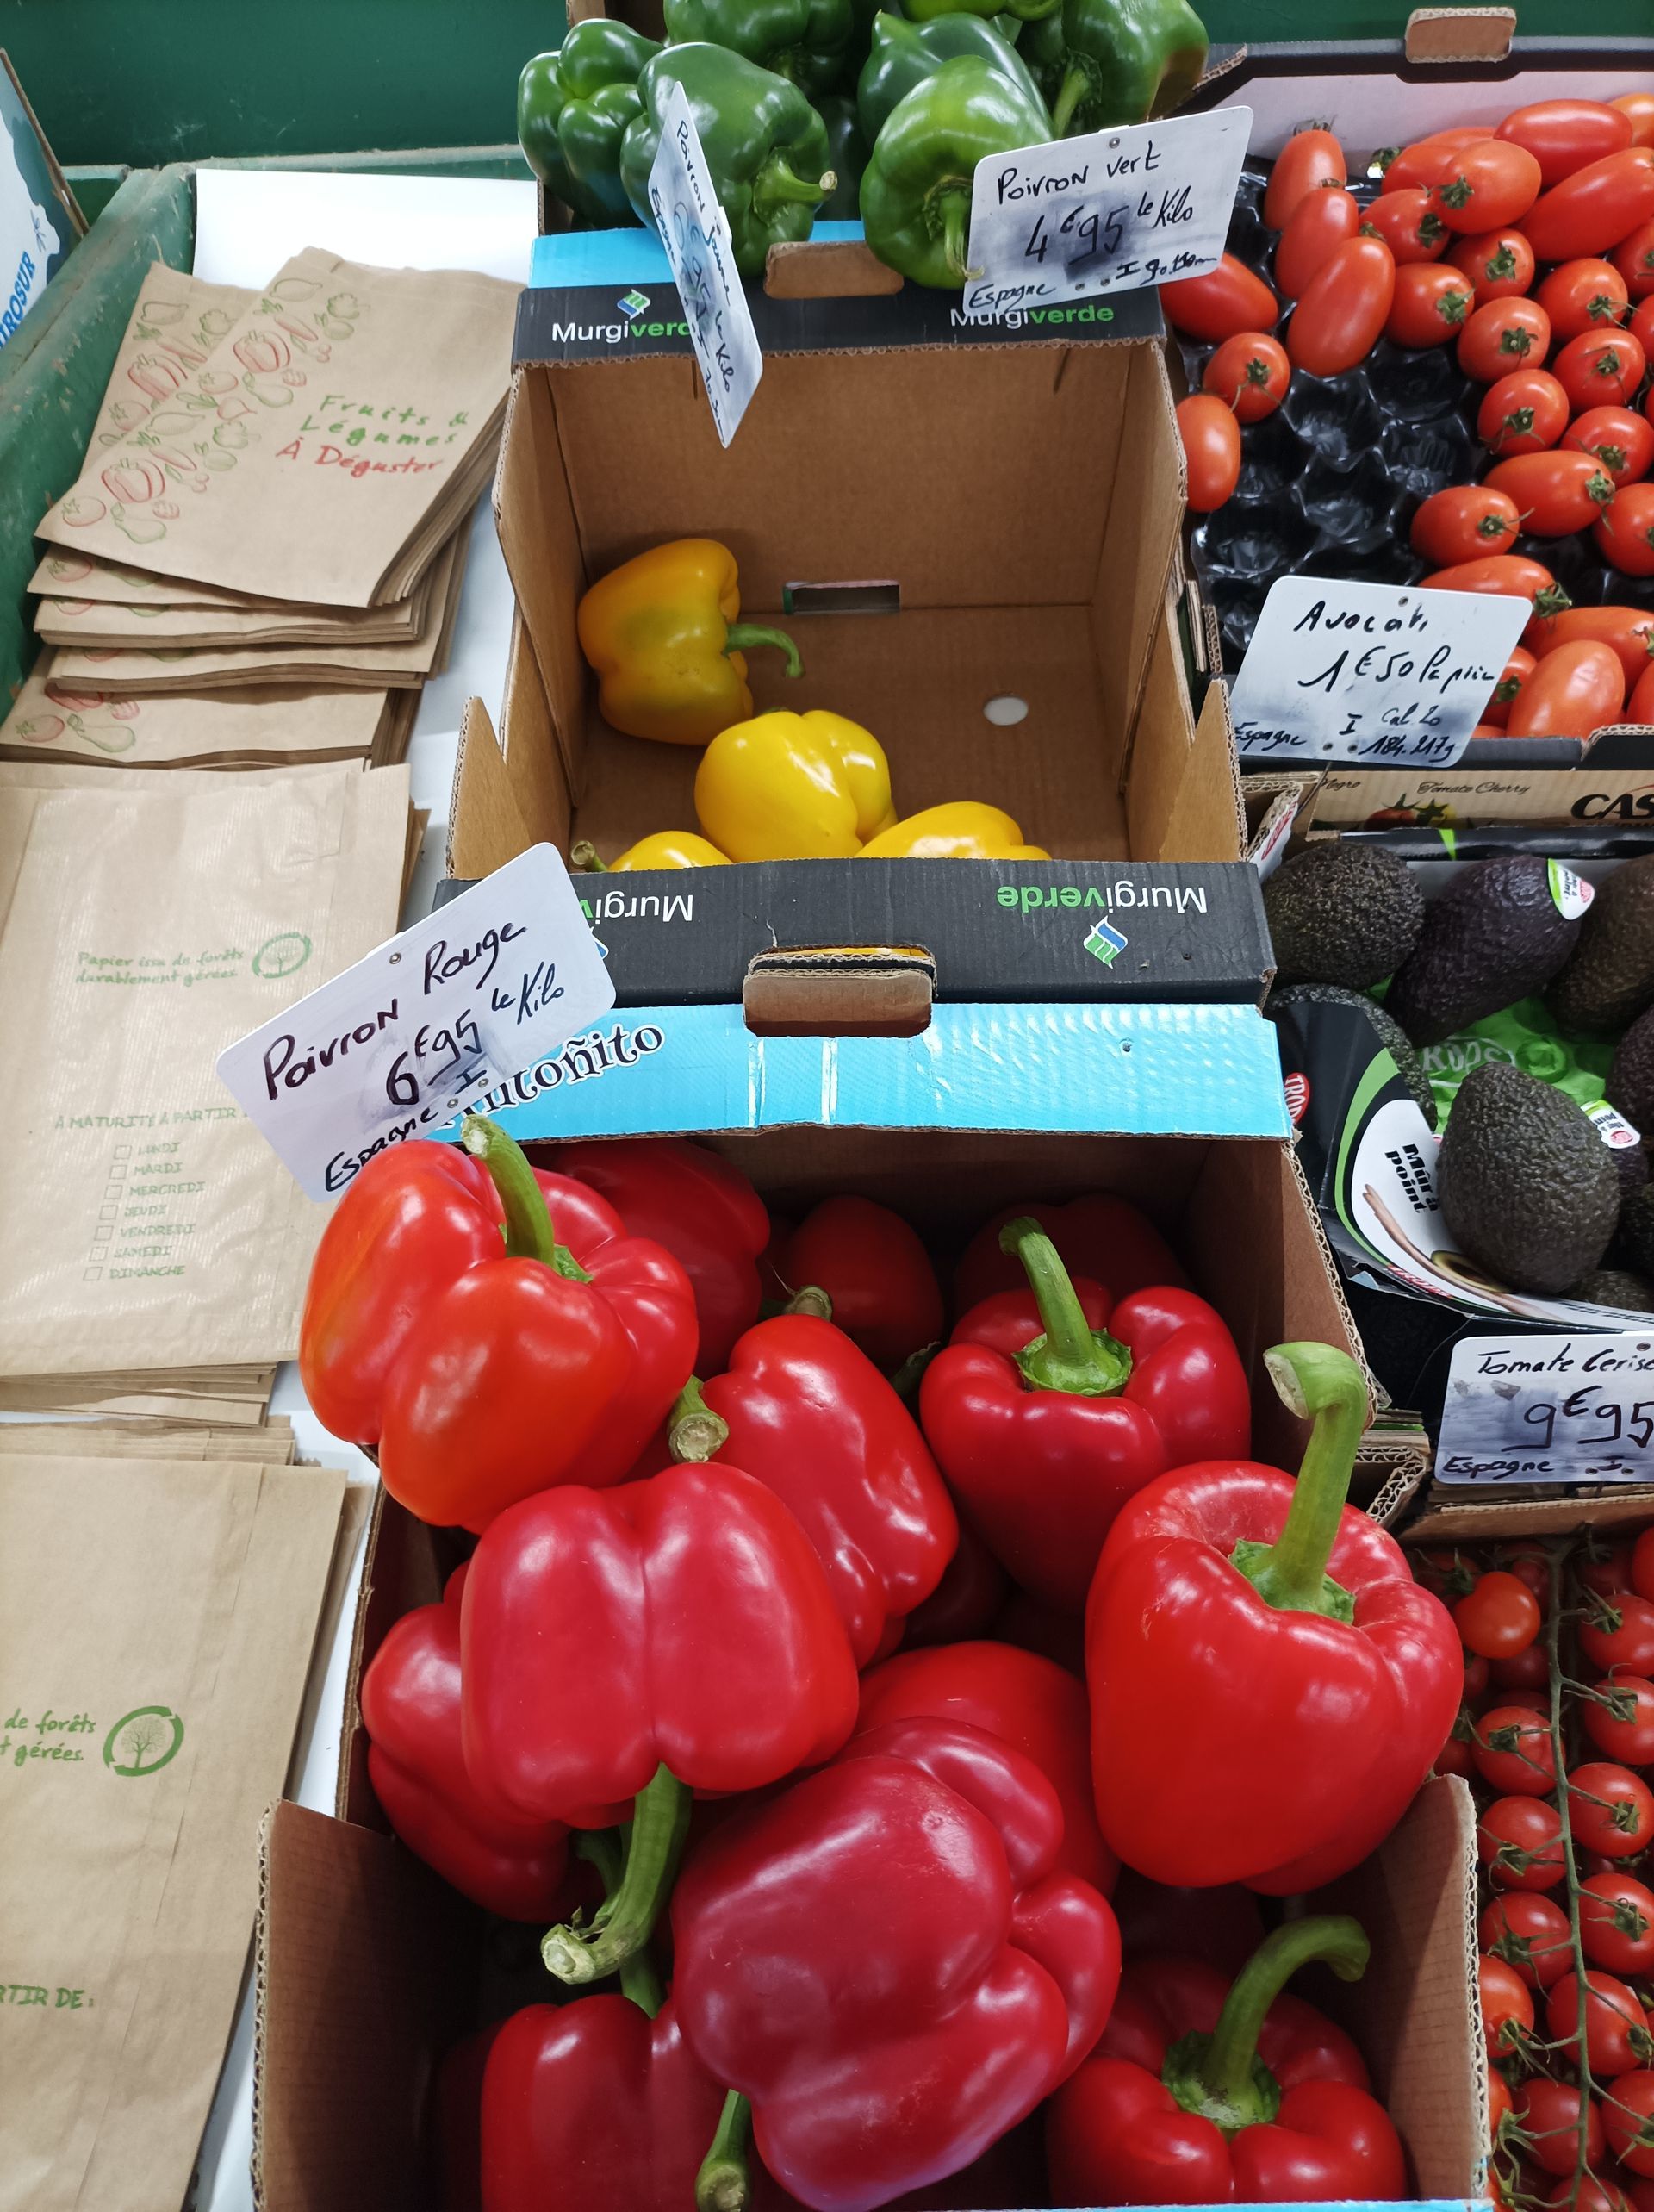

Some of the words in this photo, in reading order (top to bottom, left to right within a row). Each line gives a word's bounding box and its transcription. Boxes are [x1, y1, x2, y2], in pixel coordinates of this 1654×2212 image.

[1106, 140, 1161, 179] vert
[1152, 185, 1193, 229] Kilo
[968, 284, 1056, 315] Espagne
[550, 318, 692, 345] Murgiverd
[949, 305, 1116, 331] Murgiverde
[320, 394, 430, 427] Fruits
[299, 414, 457, 447] Légumes
[314, 444, 444, 478] Déguster
[1234, 720, 1308, 752] Espagne
[1475, 781, 1531, 795] Cherry
[579, 890, 693, 922] Murgiv
[996, 881, 1208, 914] Murgiverde
[78, 950, 134, 970] Papier
[424, 922, 527, 995] Rouge
[76, 969, 179, 985] durablement
[517, 961, 565, 1025] Kilo
[441, 1025, 662, 1125] ntoñito
[1284, 1075, 1307, 1123] TROP
[173, 1107, 237, 1124] PARTIR
[325, 1108, 439, 1193] Espagne
[134, 1163, 183, 1176] MARDI
[1384, 1150, 1428, 1214] point
[129, 1181, 207, 1197] MERCREDI
[124, 1205, 168, 1218] JEUDI
[120, 1224, 196, 1237] VENDREDI
[114, 1245, 173, 1259] SAMEDI
[109, 1265, 186, 1280] DIMANCHE
[1477, 1343, 1575, 1375] Tomate
[1443, 1456, 1556, 1480] Espagne
[4, 1707, 28, 1730] de
[35, 1710, 96, 1735] forêts
